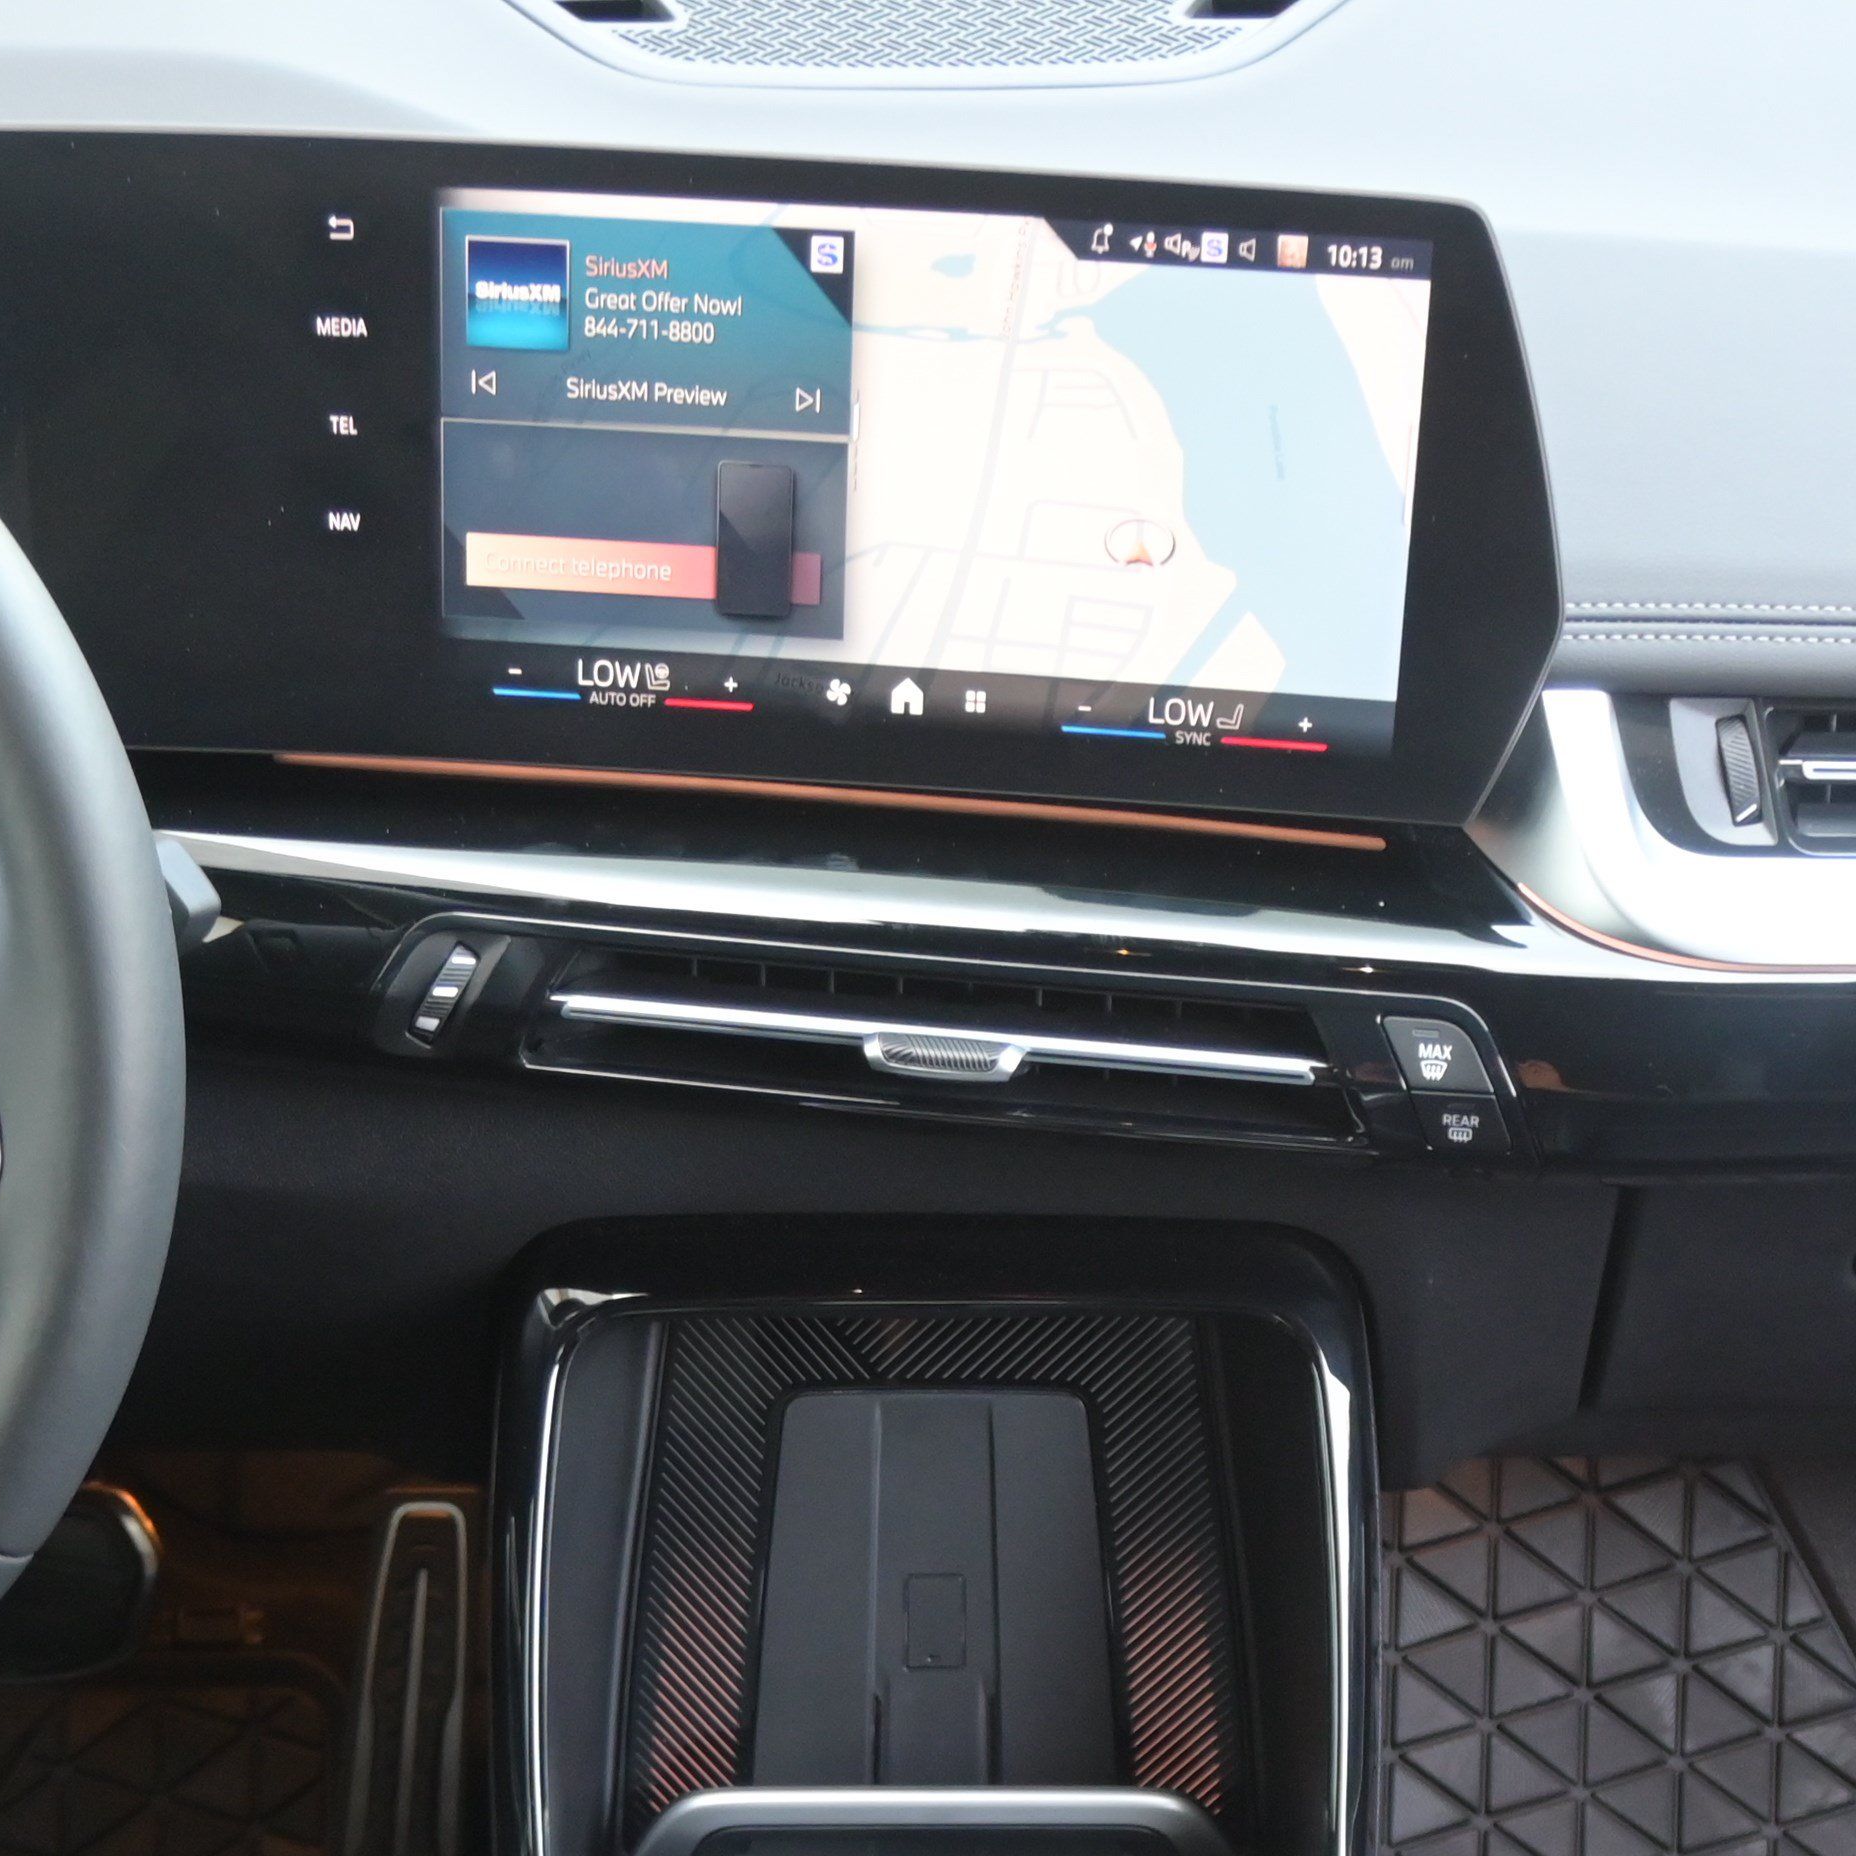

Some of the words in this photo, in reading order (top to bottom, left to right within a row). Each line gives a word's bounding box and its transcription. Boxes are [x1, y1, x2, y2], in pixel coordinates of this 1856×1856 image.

[585, 255, 669, 280] SiriusXM
[1327, 244, 1383, 270] 10:13
[475, 280, 561, 303] SiriusXM
[585, 288, 635, 313] Great
[640, 290, 688, 314] Offer
[693, 294, 742, 316] Now!
[316, 316, 367, 339] MEDIA
[584, 318, 714, 344] 844-711-8800
[565, 378, 647, 403] SiriusXM
[654, 382, 728, 407] Preview
[330, 415, 357, 436] TEL
[328, 512, 361, 533] NAV
[484, 550, 565, 576] Connect
[572, 554, 672, 582] telephone
[577, 659, 641, 688] LOW
[589, 690, 623, 706] AUTO
[628, 691, 656, 707] OFF
[1149, 698, 1213, 727] LOW
[1175, 731, 1211, 746] SYNC
[1418, 1043, 1452, 1061] MAX
[1442, 1114, 1479, 1128] REAR
